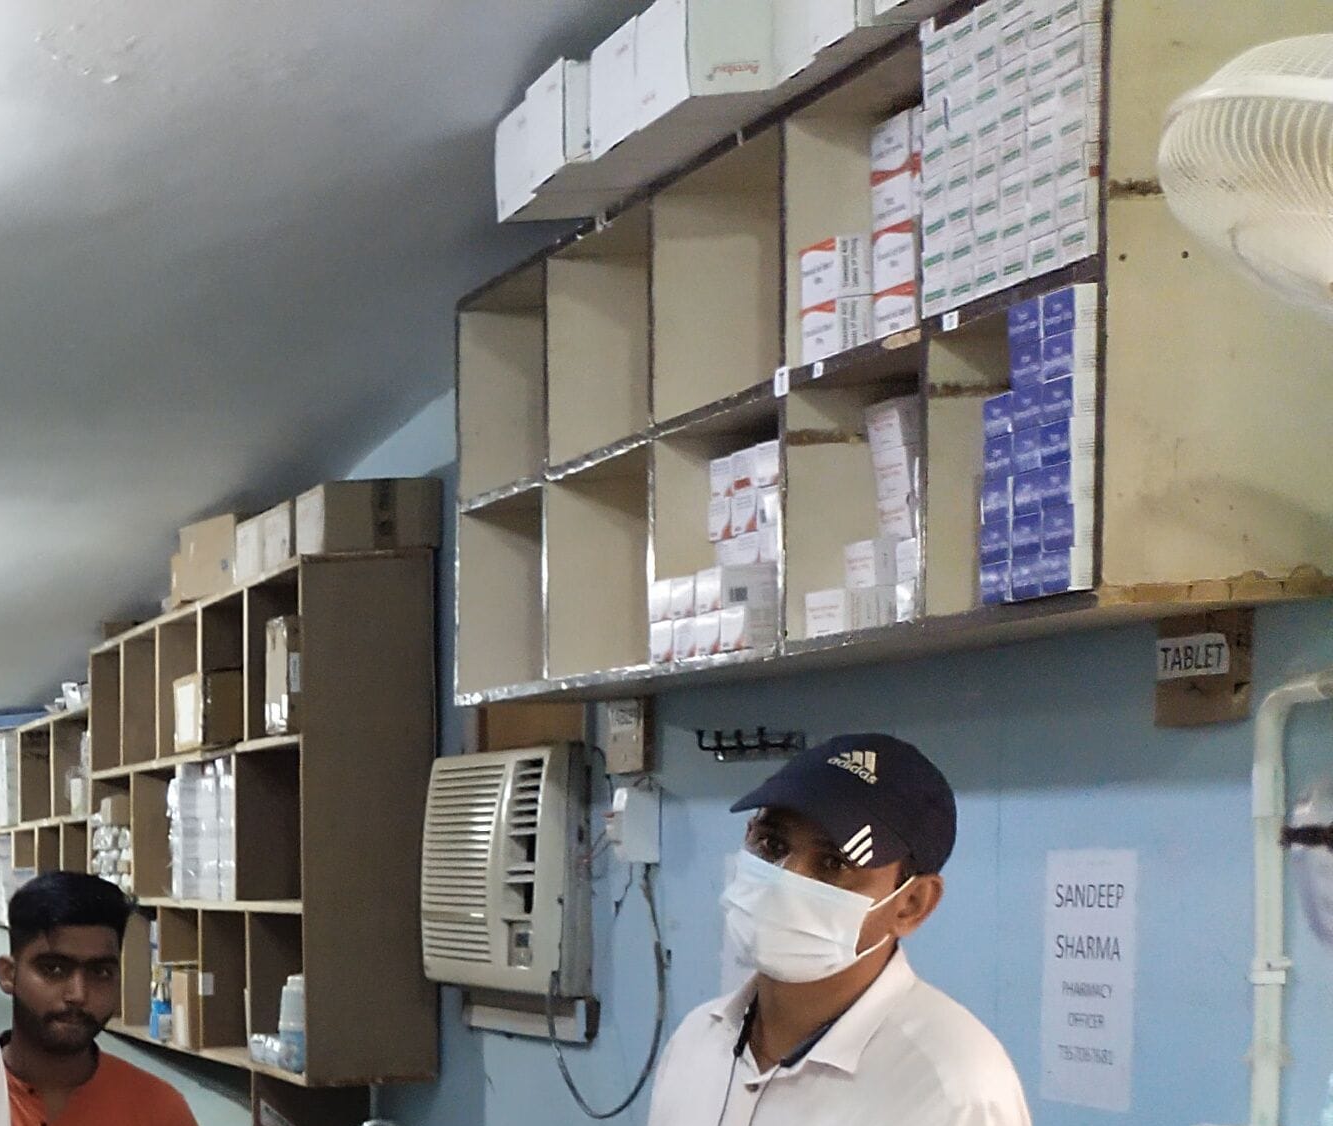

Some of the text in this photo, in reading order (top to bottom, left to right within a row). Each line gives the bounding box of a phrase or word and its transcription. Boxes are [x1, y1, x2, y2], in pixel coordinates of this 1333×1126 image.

[1160, 643, 1225, 671] TABLET
[827, 757, 882, 784] adidas
[1054, 883, 1125, 909] SANDEEP
[1054, 934, 1122, 961] SHARMA
[1061, 980, 1114, 999] PHARMACY
[1067, 1012, 1106, 1029] OFFICER
